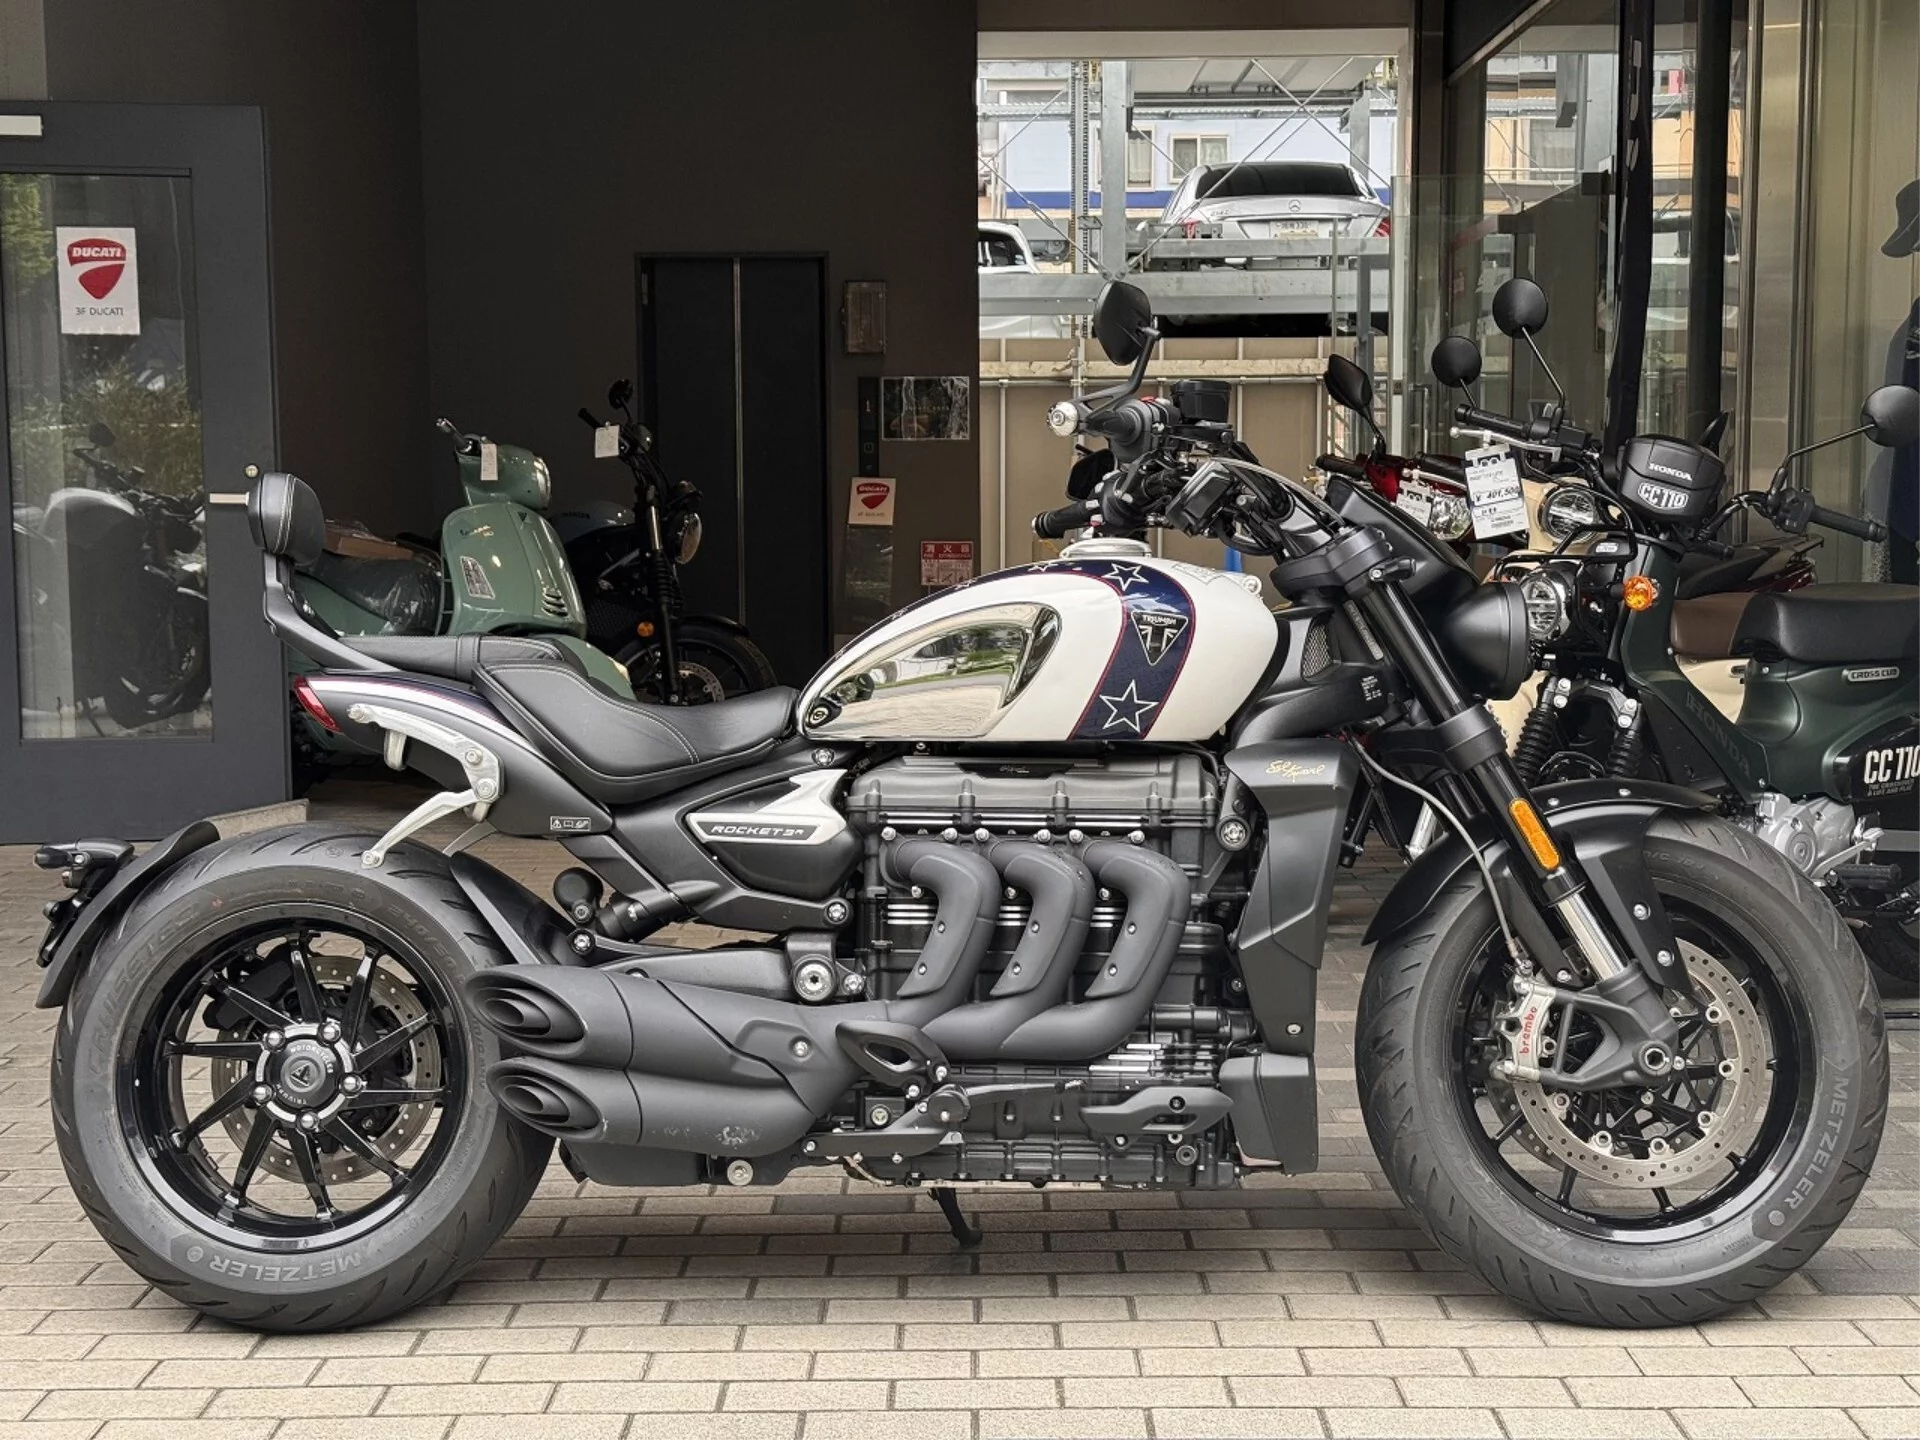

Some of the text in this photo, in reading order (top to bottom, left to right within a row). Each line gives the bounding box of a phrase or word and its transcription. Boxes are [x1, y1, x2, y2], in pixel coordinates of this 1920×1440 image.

[72, 247, 122, 258] DUCATI
[75, 307, 124, 316] 3F DUCATI
[1648, 463, 1693, 481] HONDA
[1640, 483, 1686, 508] CC110
[1142, 614, 1177, 625] TRIUMPH
[1850, 668, 1898, 680] CROSS CUB
[1519, 1006, 1538, 1054] brembo
[290, 1044, 334, 1073] MOTORCYCLES
[1784, 1072, 1849, 1210] METZELER
[209, 1252, 361, 1282] METZELER
